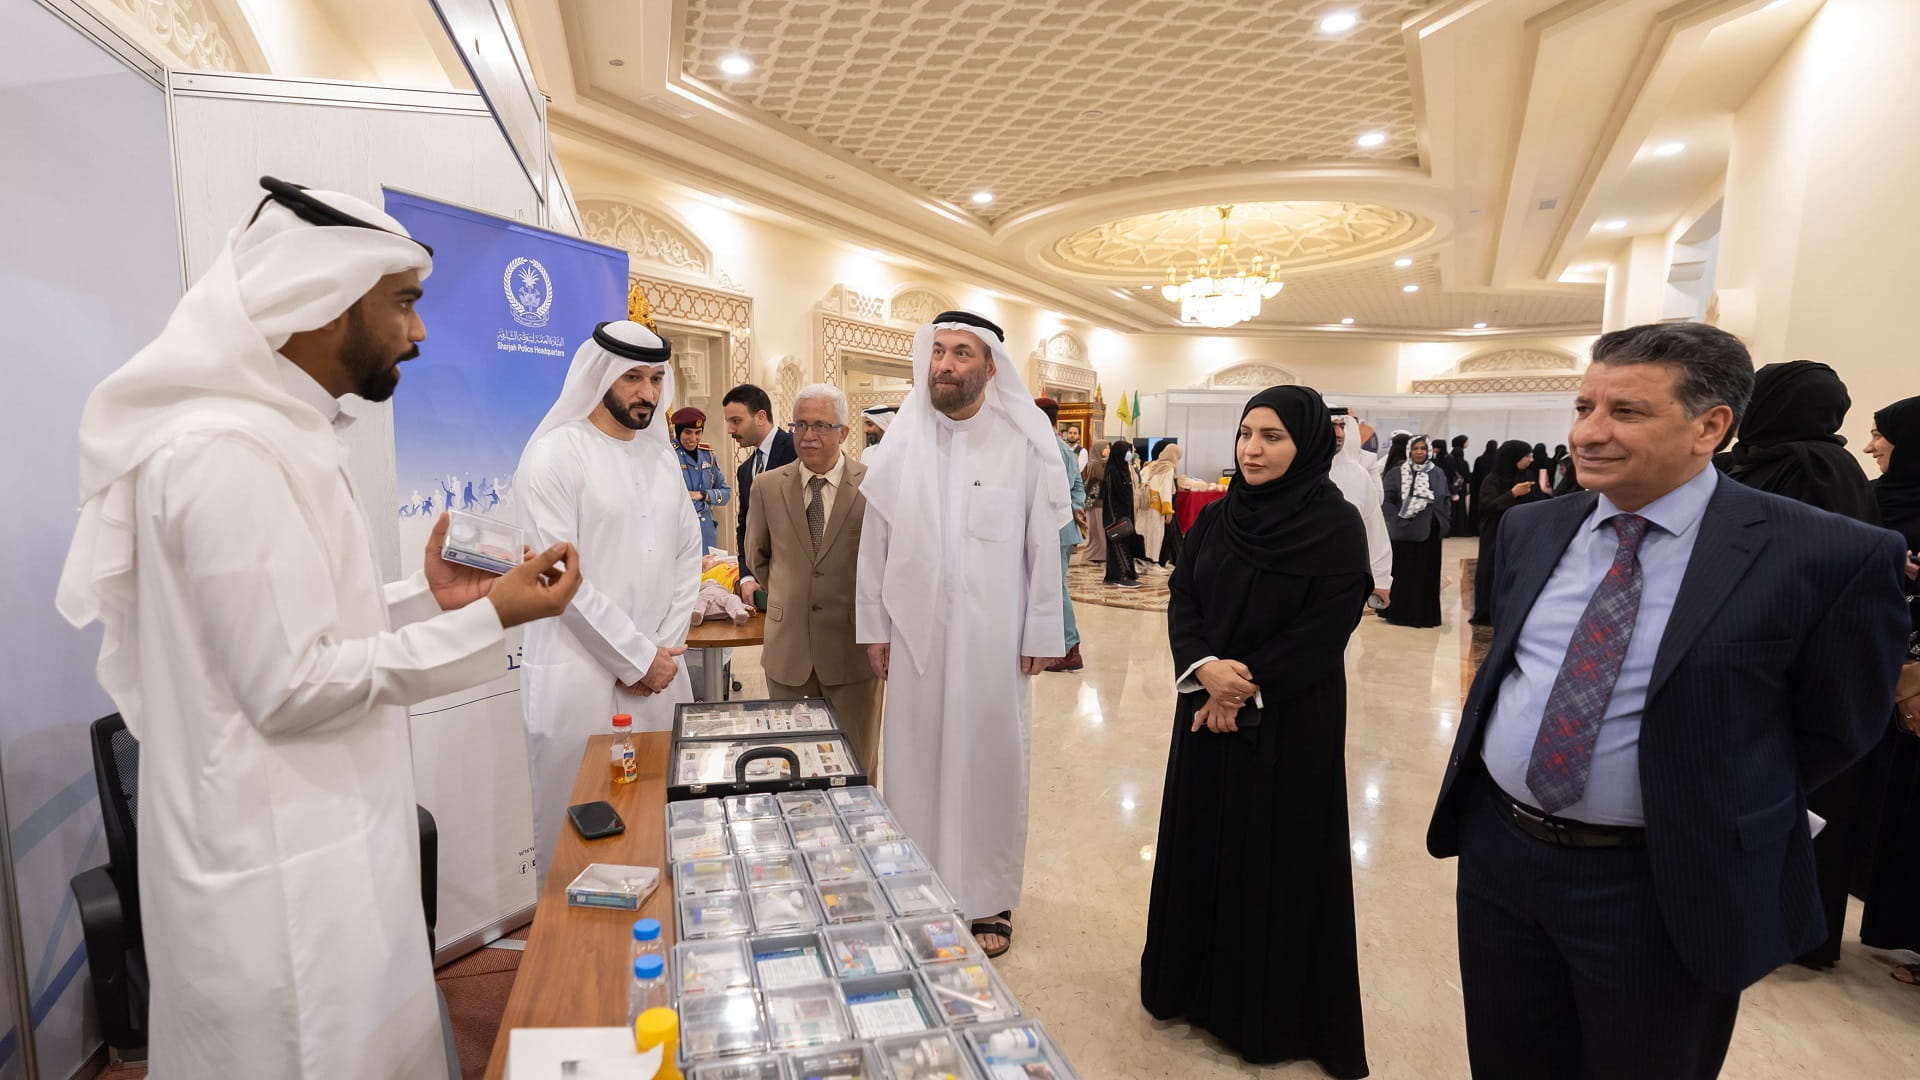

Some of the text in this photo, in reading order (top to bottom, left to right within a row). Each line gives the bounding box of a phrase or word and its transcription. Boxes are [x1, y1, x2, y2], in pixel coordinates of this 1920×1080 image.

[497, 341, 565, 357] Sharjah Police Headquarters
